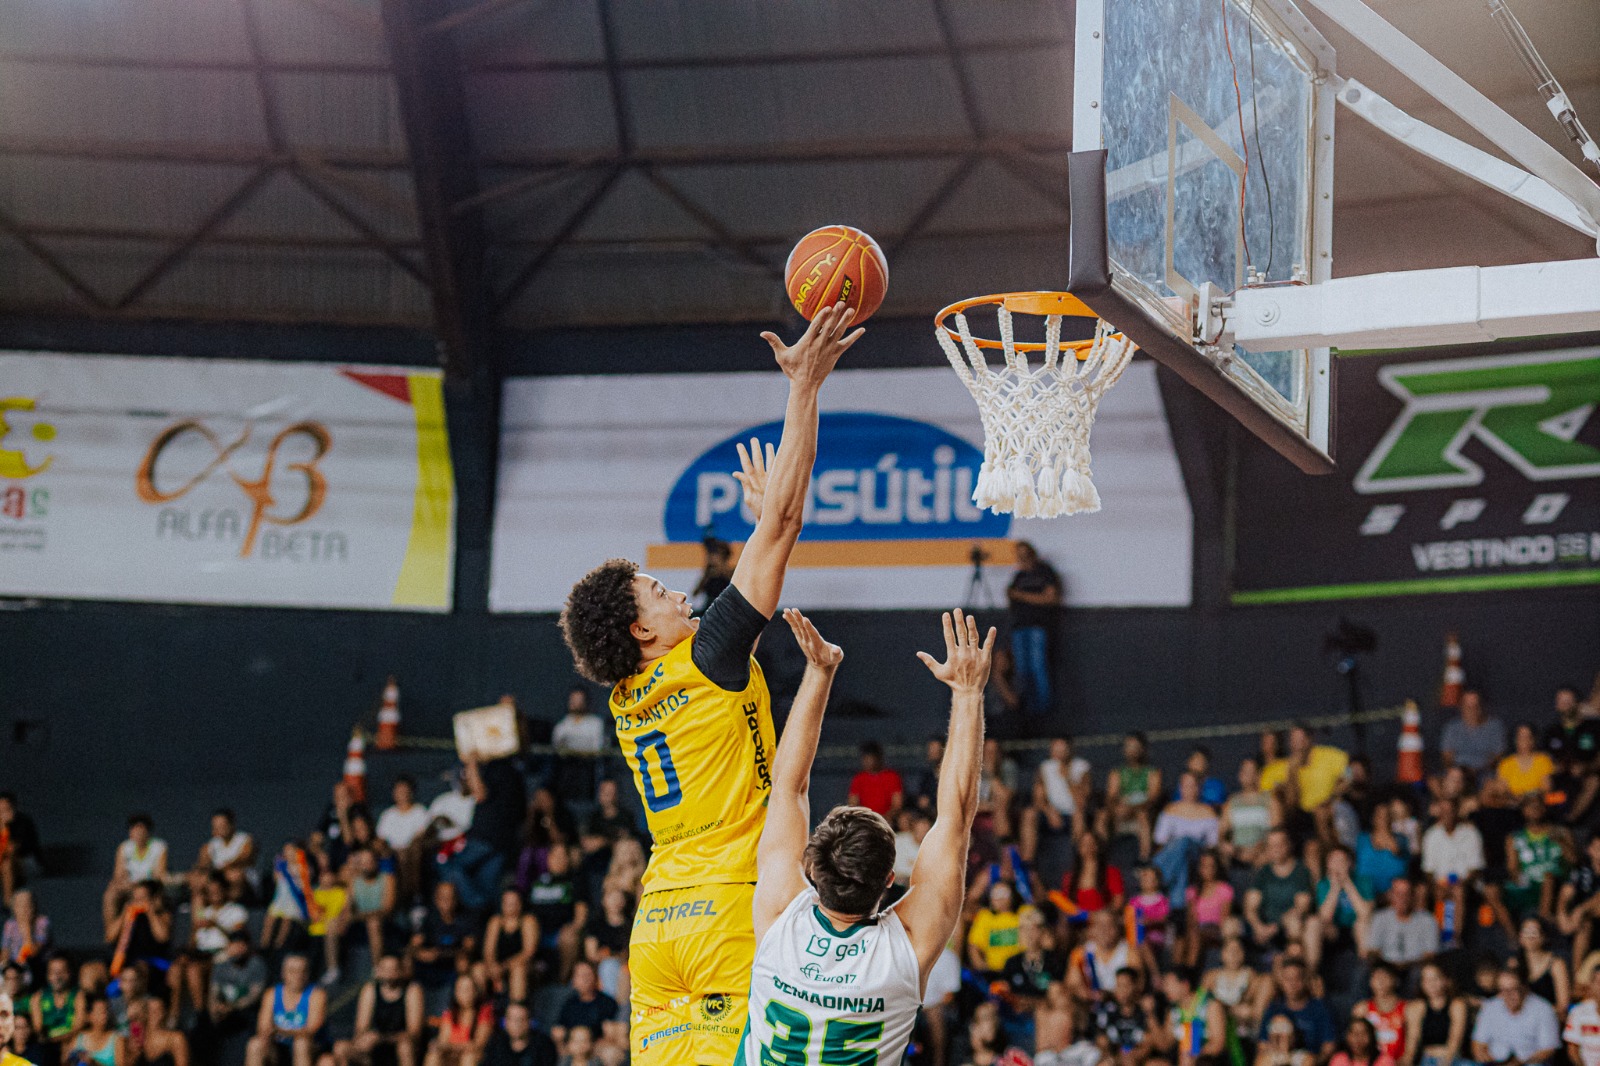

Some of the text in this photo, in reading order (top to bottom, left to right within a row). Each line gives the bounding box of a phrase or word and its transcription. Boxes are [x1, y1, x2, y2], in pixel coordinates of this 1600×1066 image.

[155, 506, 240, 541] ALFA
[260, 527, 349, 564] BETA
[635, 687, 690, 728] SANTOS
[634, 728, 683, 813] 0
